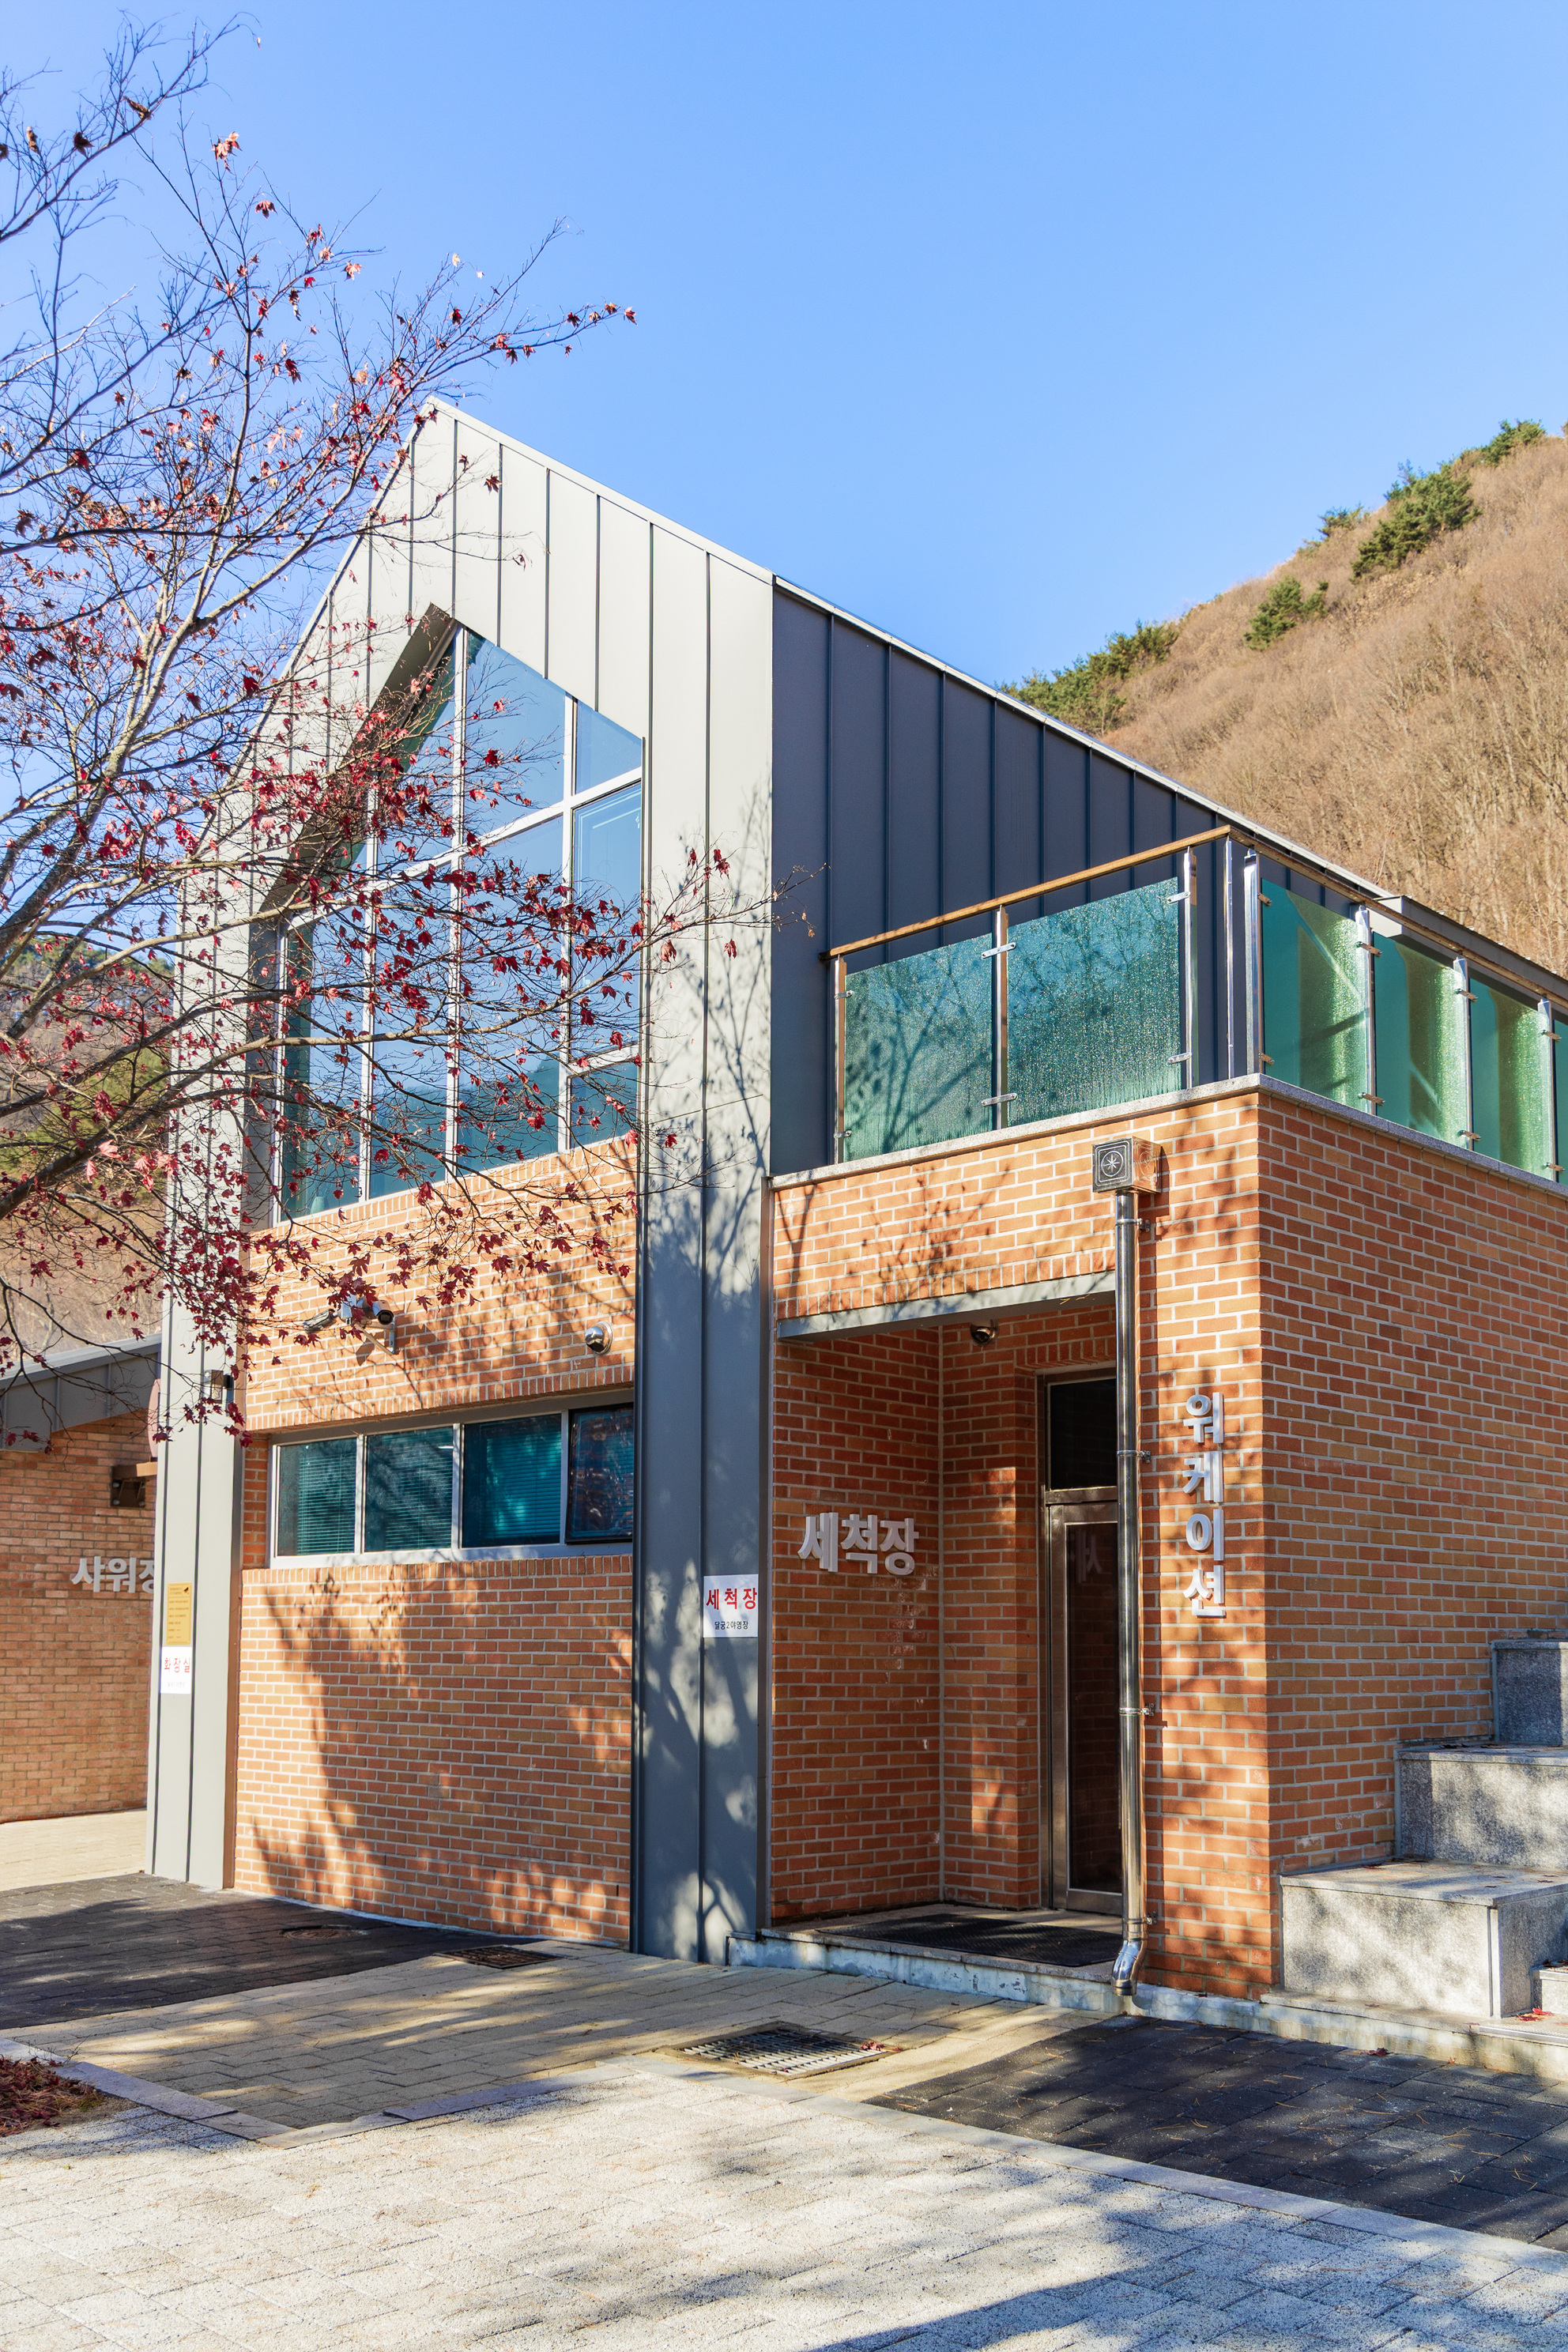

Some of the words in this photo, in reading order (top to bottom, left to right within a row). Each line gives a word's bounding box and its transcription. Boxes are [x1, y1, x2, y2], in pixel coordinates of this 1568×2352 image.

[1182, 1392, 1225, 1616] 워케이션
[797, 1512, 919, 1575] 세척장
[706, 1587, 757, 1610] 세척장
[714, 1620, 748, 1630] 달궁2야영장
[164, 1657, 190, 1673] 화장실
